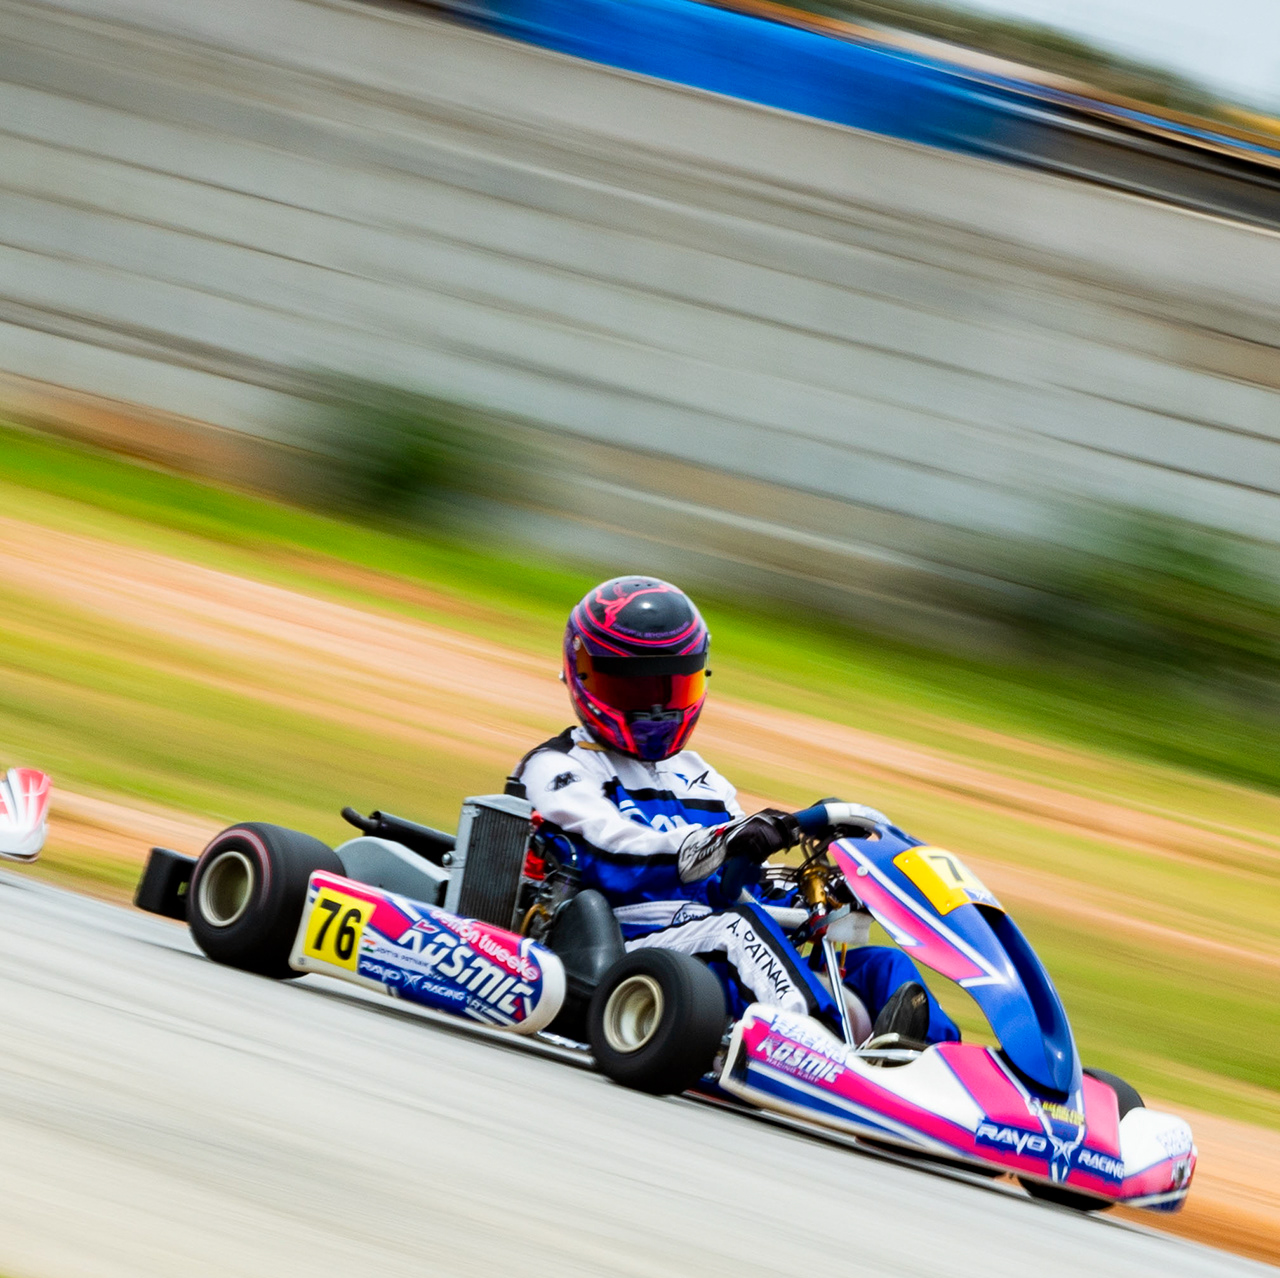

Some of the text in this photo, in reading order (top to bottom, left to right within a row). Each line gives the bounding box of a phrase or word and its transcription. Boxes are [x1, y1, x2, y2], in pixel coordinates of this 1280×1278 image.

[928, 855, 964, 883] 7
[312, 898, 362, 961] 76
[478, 934, 540, 981] tweeks
[726, 917, 792, 1000] A. PATNAIK
[421, 981, 467, 1001] RACING
[755, 1034, 846, 1084] KOSMIC
[766, 1056, 798, 1075] RACING
[976, 1122, 1125, 1180] RAYO RACING
